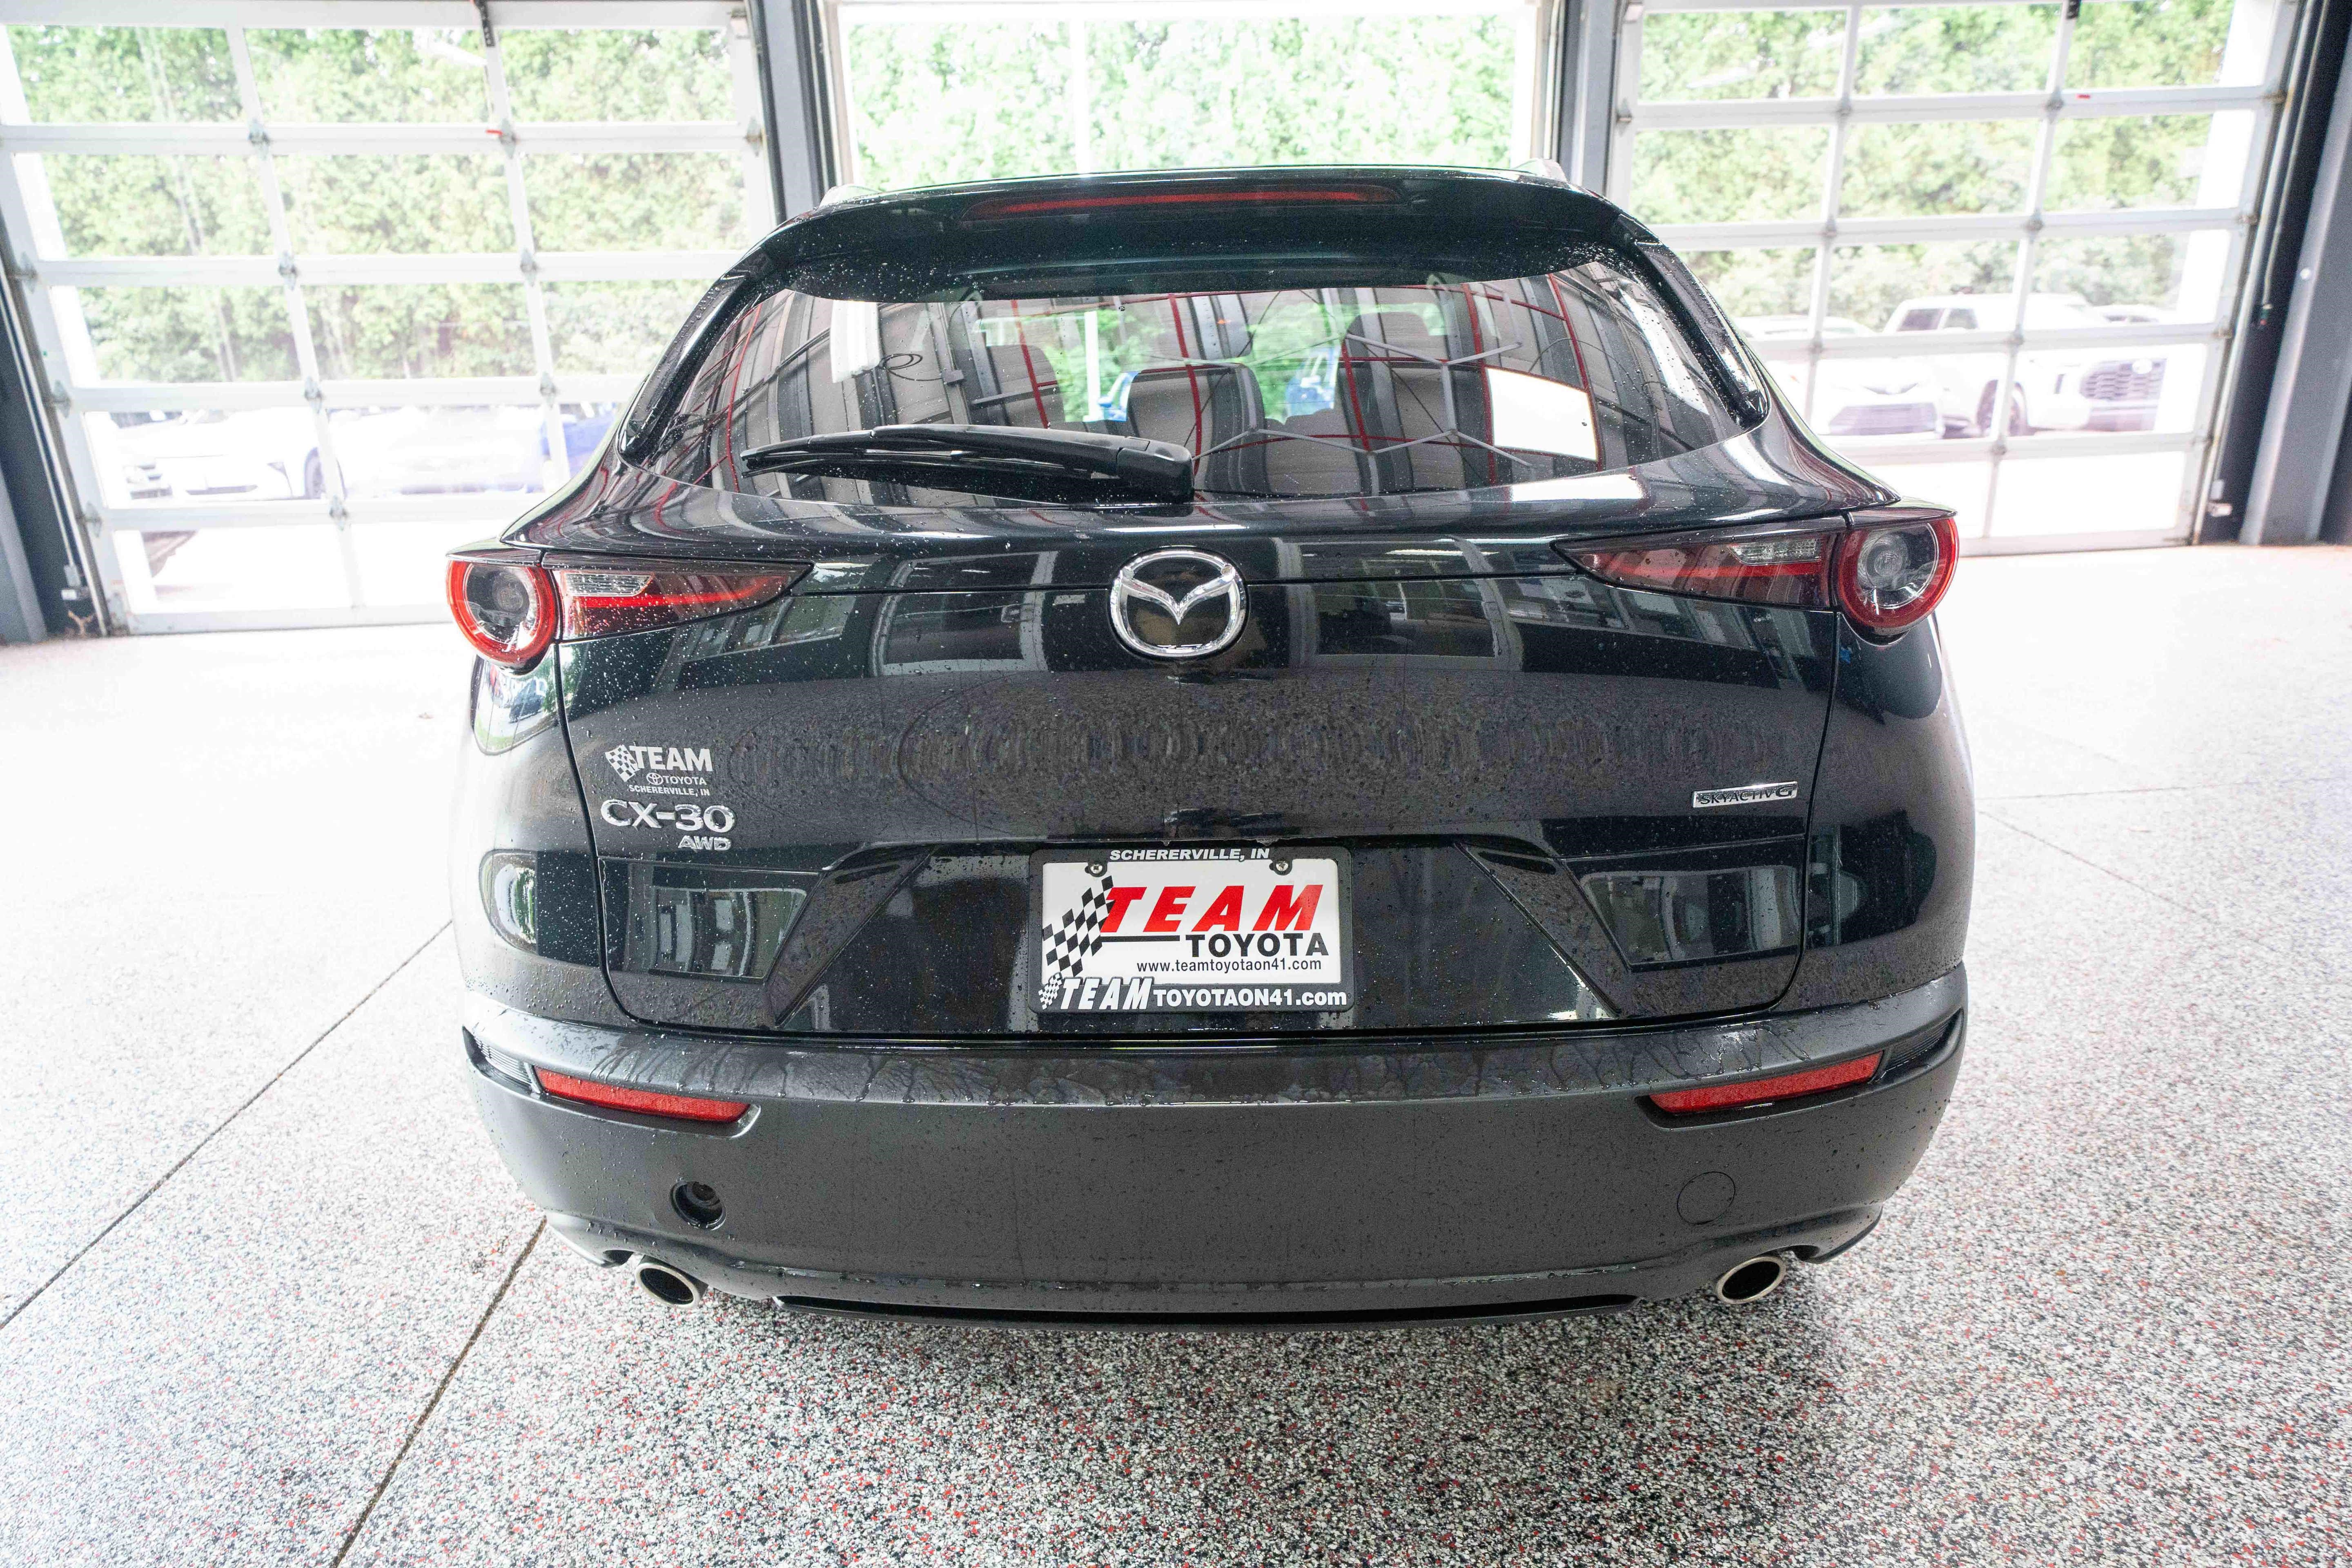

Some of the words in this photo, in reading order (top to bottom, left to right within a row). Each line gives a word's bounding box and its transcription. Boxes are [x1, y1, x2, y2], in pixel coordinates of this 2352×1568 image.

[629, 745, 713, 771] TEAM
[664, 775, 707, 785] TOYOTA
[629, 784, 698, 797] SCHERERVILLE,
[700, 788, 710, 796] IN
[1700, 789, 1773, 804] SKYACTIV
[600, 799, 735, 833] CX-30
[678, 835, 731, 851] AWD
[1109, 849, 1246, 862] SCHERERVILLE,
[1250, 848, 1270, 859] IN
[1100, 884, 1324, 933] TEAM
[1185, 933, 1330, 958] TOYOTA
[1137, 958, 1322, 974] www.teamtoyotaon41.com
[1060, 978, 1152, 1010] TEAM
[1153, 989, 1348, 1007] TOYOTAON41.com
